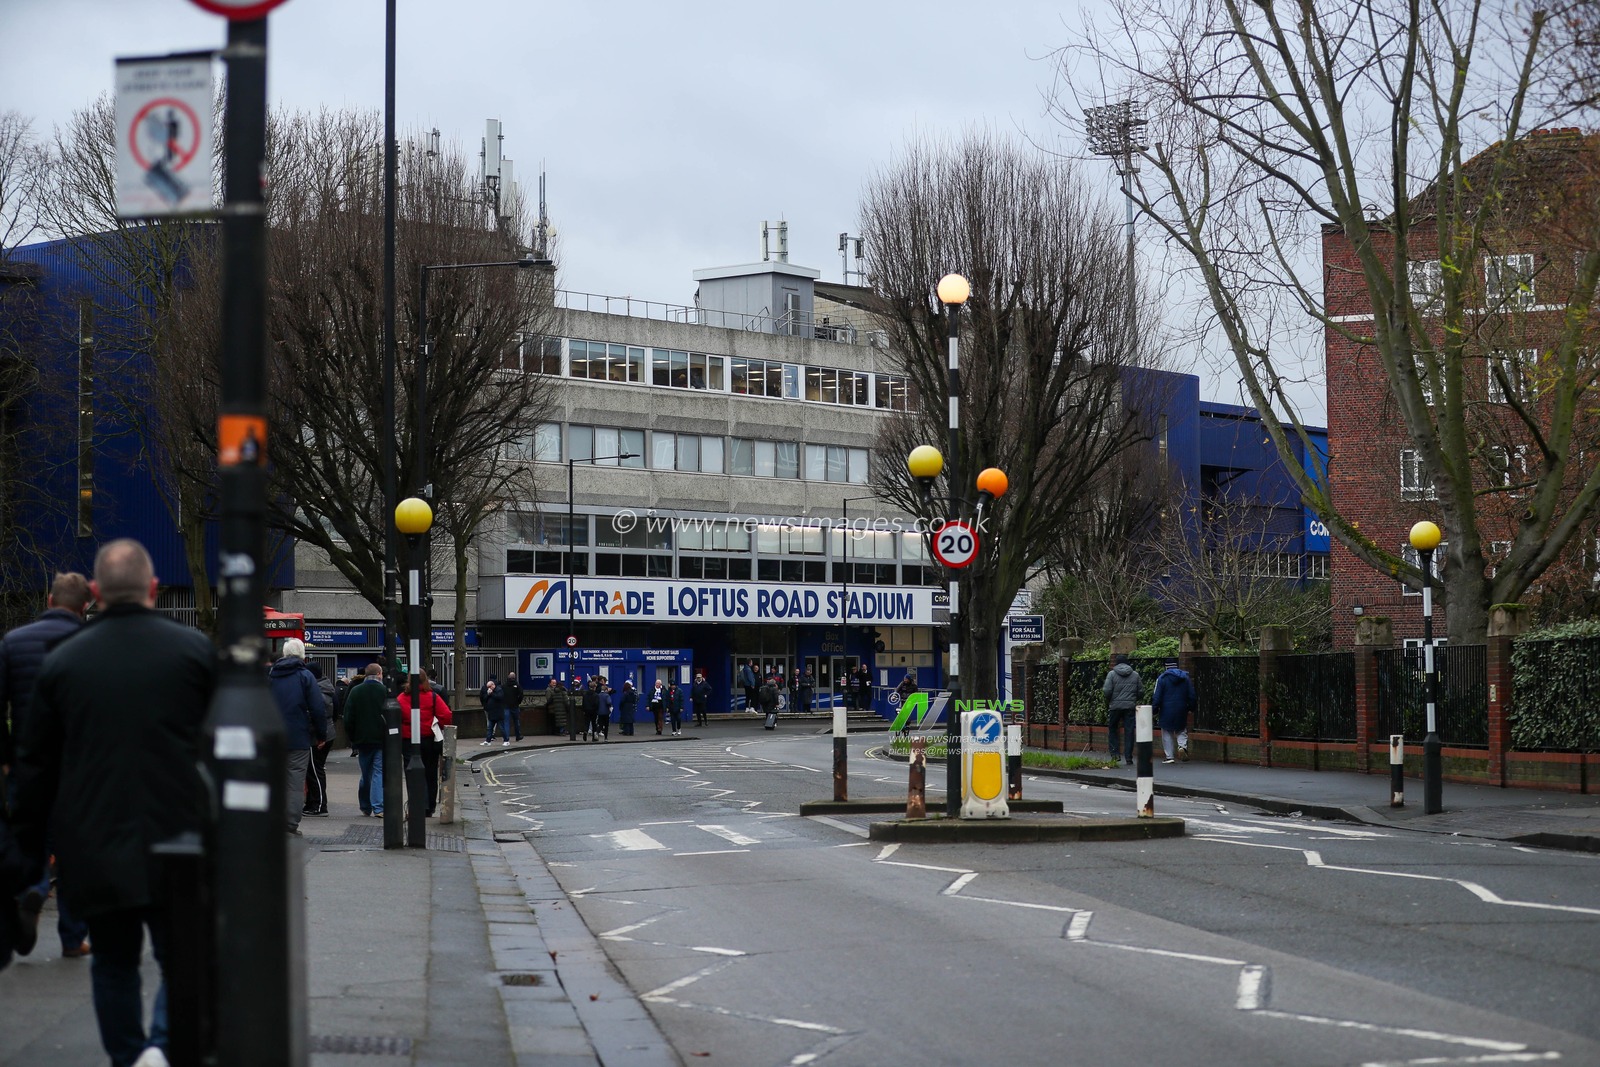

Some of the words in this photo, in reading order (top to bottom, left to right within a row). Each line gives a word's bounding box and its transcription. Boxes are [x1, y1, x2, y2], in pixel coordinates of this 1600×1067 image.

[941, 535, 972, 554] 20
[668, 587, 749, 617] LOFTUS
[757, 589, 819, 618] ROAD
[827, 590, 913, 620] STADIUM
[825, 631, 839, 641] Box
[821, 642, 844, 652] Office
